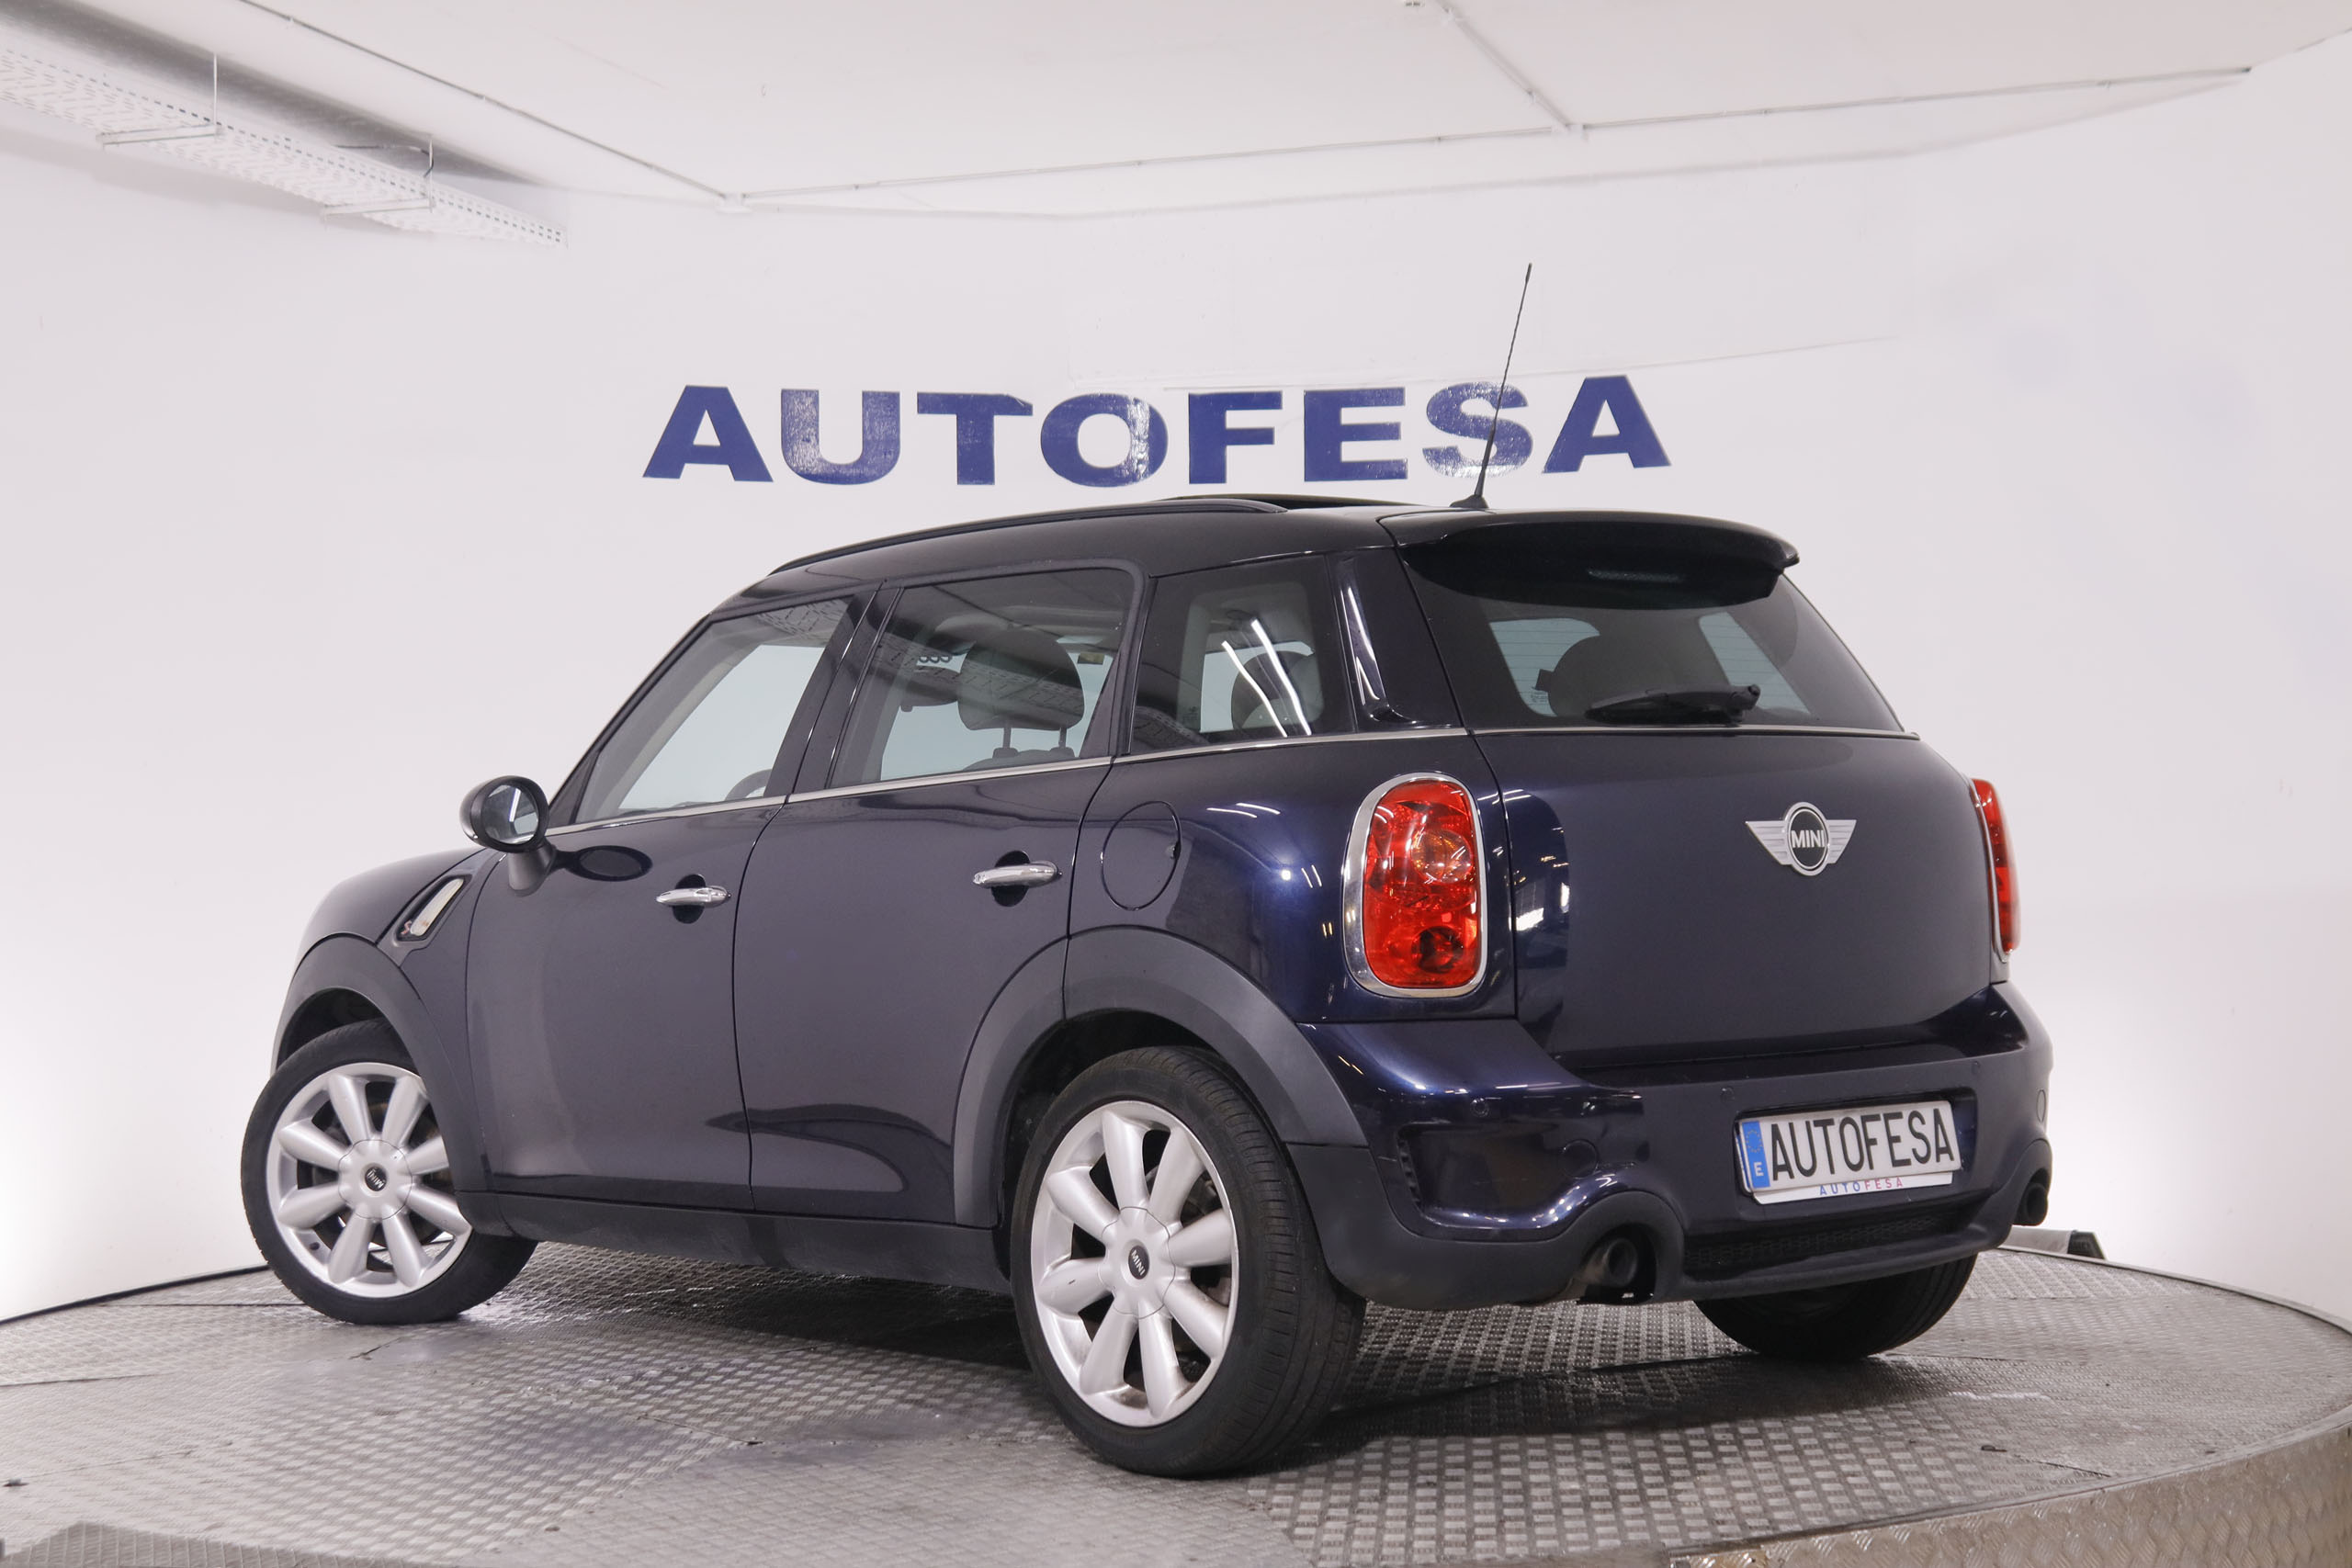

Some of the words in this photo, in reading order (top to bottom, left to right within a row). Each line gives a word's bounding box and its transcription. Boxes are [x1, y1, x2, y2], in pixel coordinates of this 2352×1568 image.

[642, 375, 1670, 487] AUTOFESA
[1791, 829, 1826, 848] MINI
[1770, 1108, 1954, 1181] AUTOFESA
[367, 1168, 384, 1189] MINI
[1753, 1162, 1764, 1177] E
[1818, 1176, 1904, 1196] AUTOFESA
[1131, 1249, 1146, 1276] MINI
